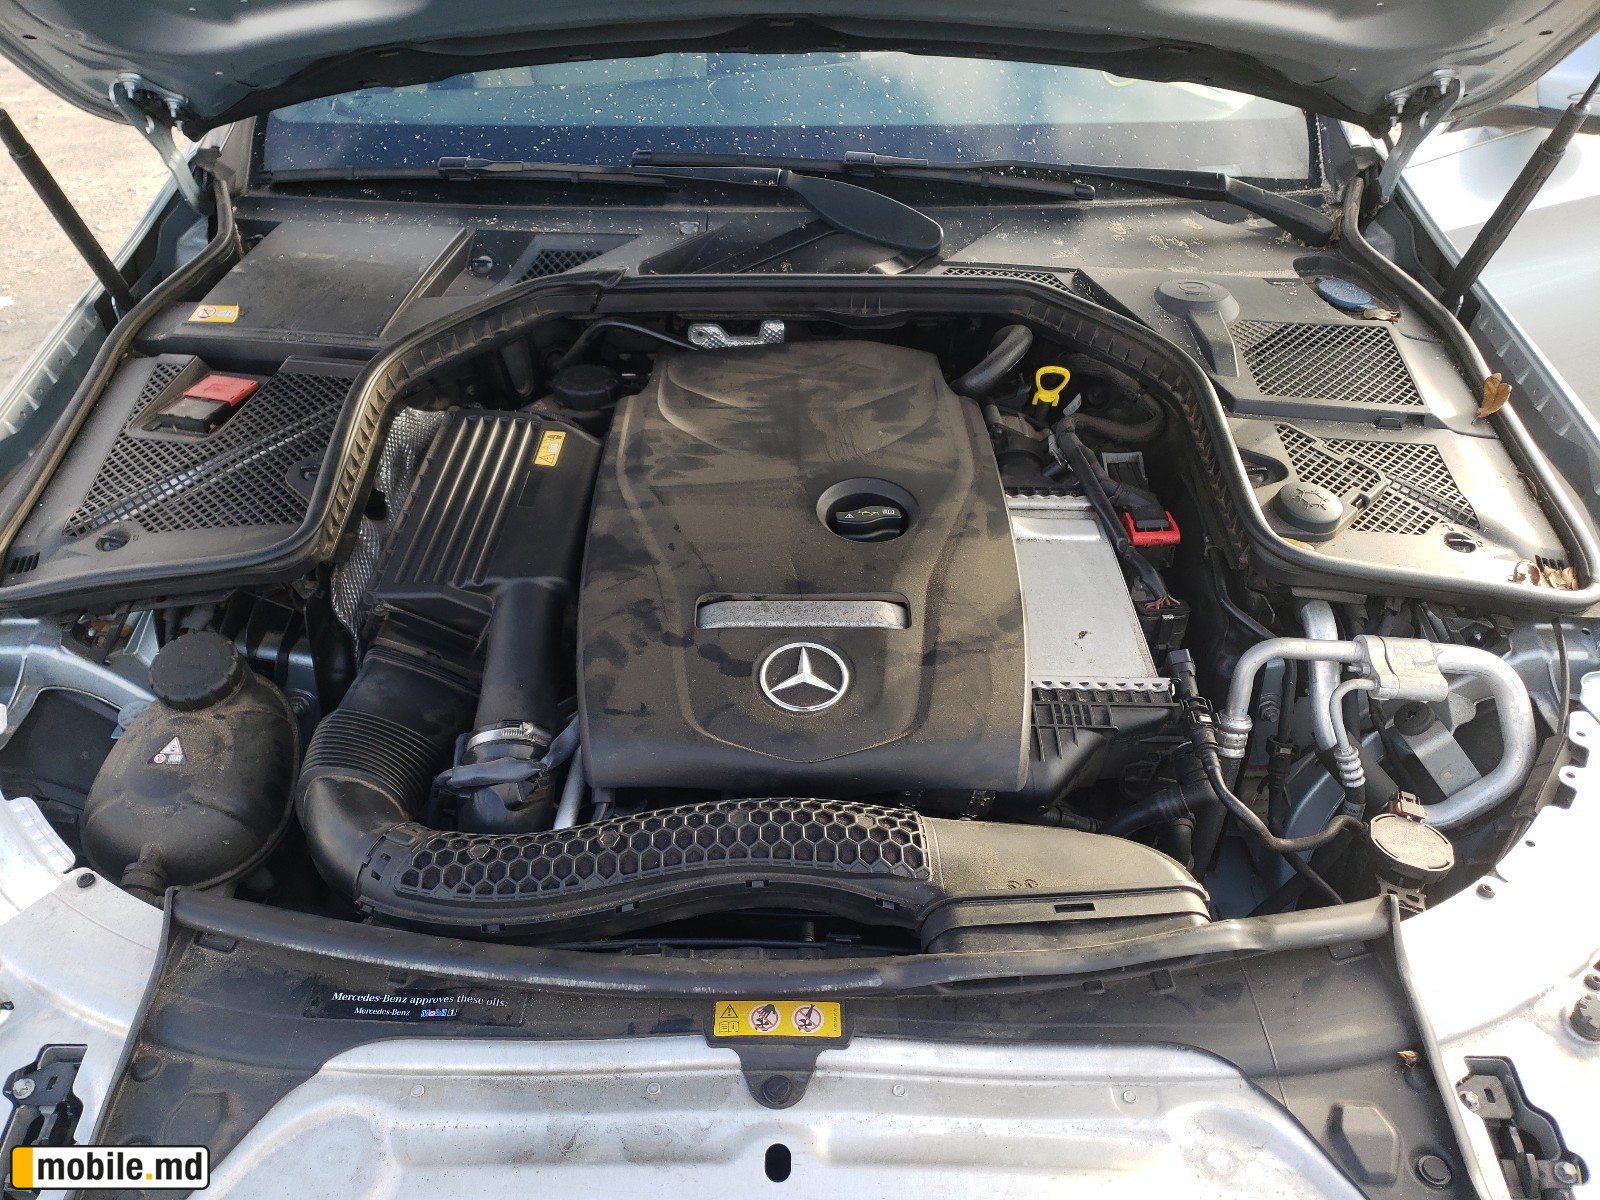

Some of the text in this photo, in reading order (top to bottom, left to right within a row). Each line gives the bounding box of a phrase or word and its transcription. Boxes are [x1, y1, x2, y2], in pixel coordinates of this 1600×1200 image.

[332, 992, 407, 1003] Mercedes-Benz
[409, 996, 454, 1006] approves
[457, 994, 484, 1004] these
[354, 1007, 410, 1016] Mercedes-Benz
